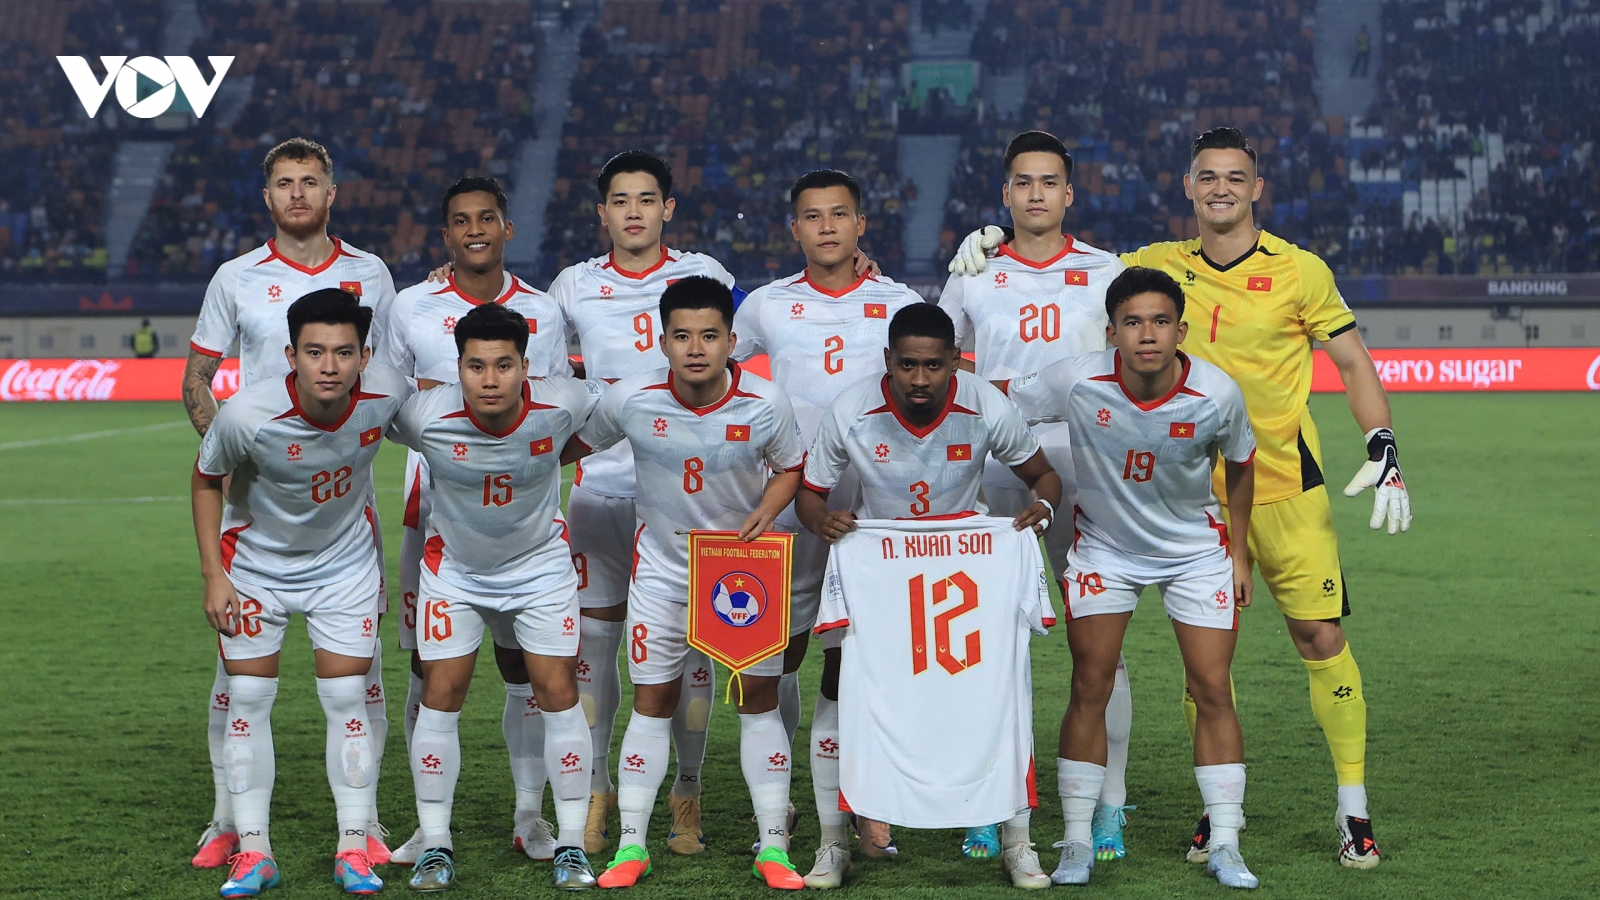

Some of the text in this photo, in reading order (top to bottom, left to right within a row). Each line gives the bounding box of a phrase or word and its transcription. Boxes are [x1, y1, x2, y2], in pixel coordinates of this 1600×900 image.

[1487, 280, 1568, 295] BANDUNG
[633, 312, 653, 352] 9
[1019, 302, 1061, 343] 20
[1209, 304, 1221, 343] 1
[824, 334, 844, 376] 2
[1439, 359, 1523, 388] sugar
[311, 464, 353, 505] 22
[683, 455, 704, 495] 8
[1122, 448, 1156, 483] 19
[482, 473, 513, 507] 15
[909, 479, 930, 517] 3
[700, 547, 780, 559] VIETNAM FOOTBALL FEDERATION
[904, 533, 951, 558] XUAN
[957, 532, 993, 555] SON
[424, 599, 453, 642] 15
[731, 612, 748, 620] VFF
[908, 570, 982, 676] 12
[631, 622, 649, 665] 8
